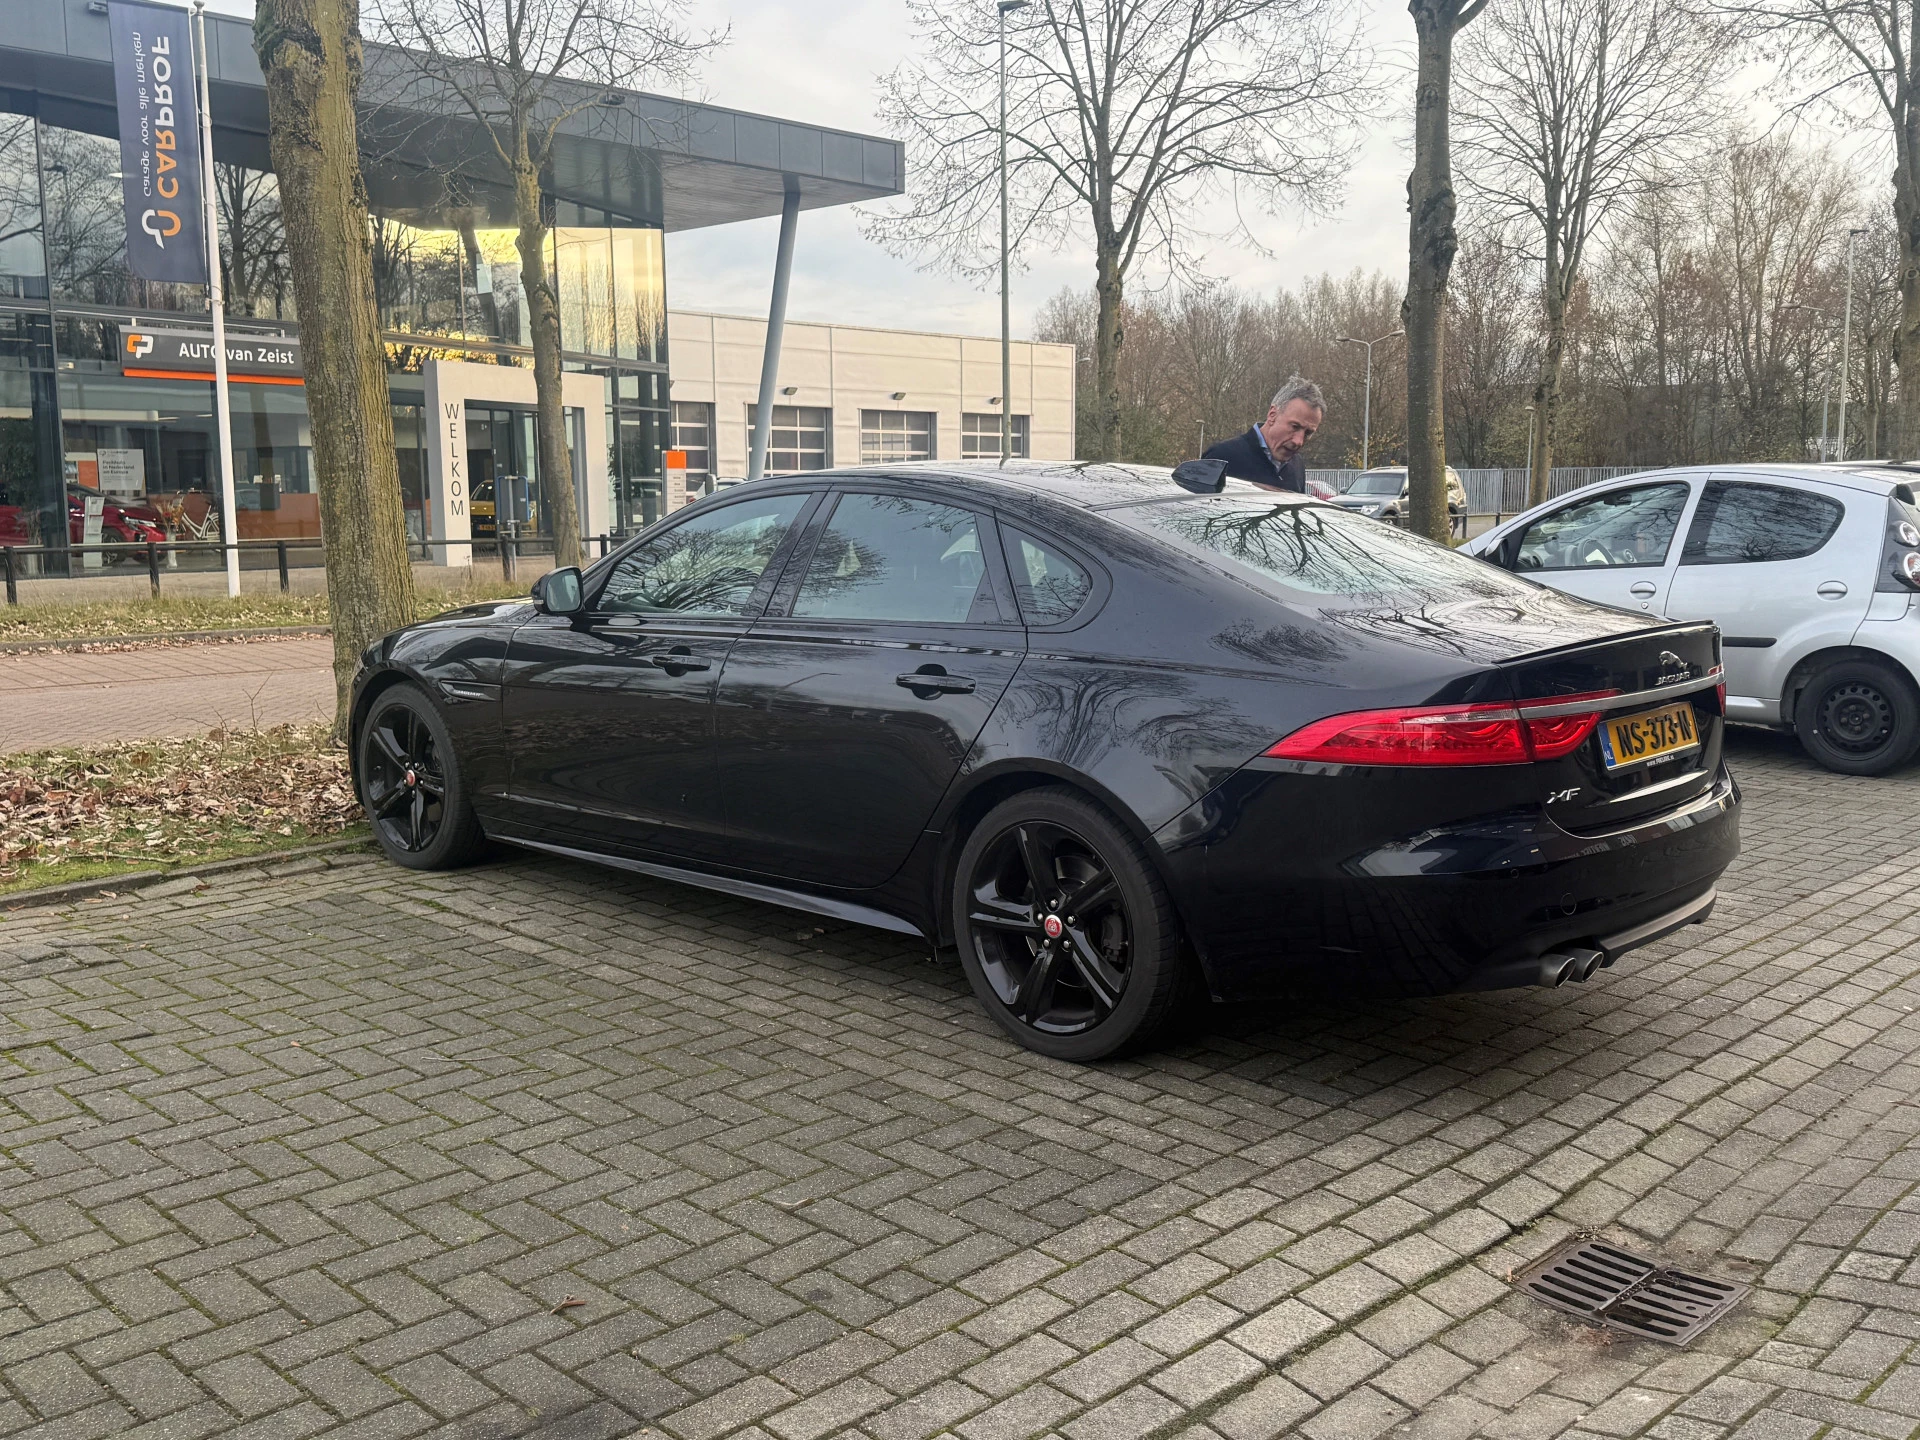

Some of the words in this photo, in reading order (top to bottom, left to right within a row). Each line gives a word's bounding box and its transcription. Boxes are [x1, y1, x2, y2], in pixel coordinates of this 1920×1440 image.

[226, 349, 253, 362] van
[257, 348, 295, 365] Zeist
[444, 402, 464, 516] WELKOM
[1654, 671, 1690, 686] JAGUAR
[1616, 710, 1692, 758] NS-373-N
[1604, 750, 1614, 760] NL
[1546, 787, 1581, 804] XF
